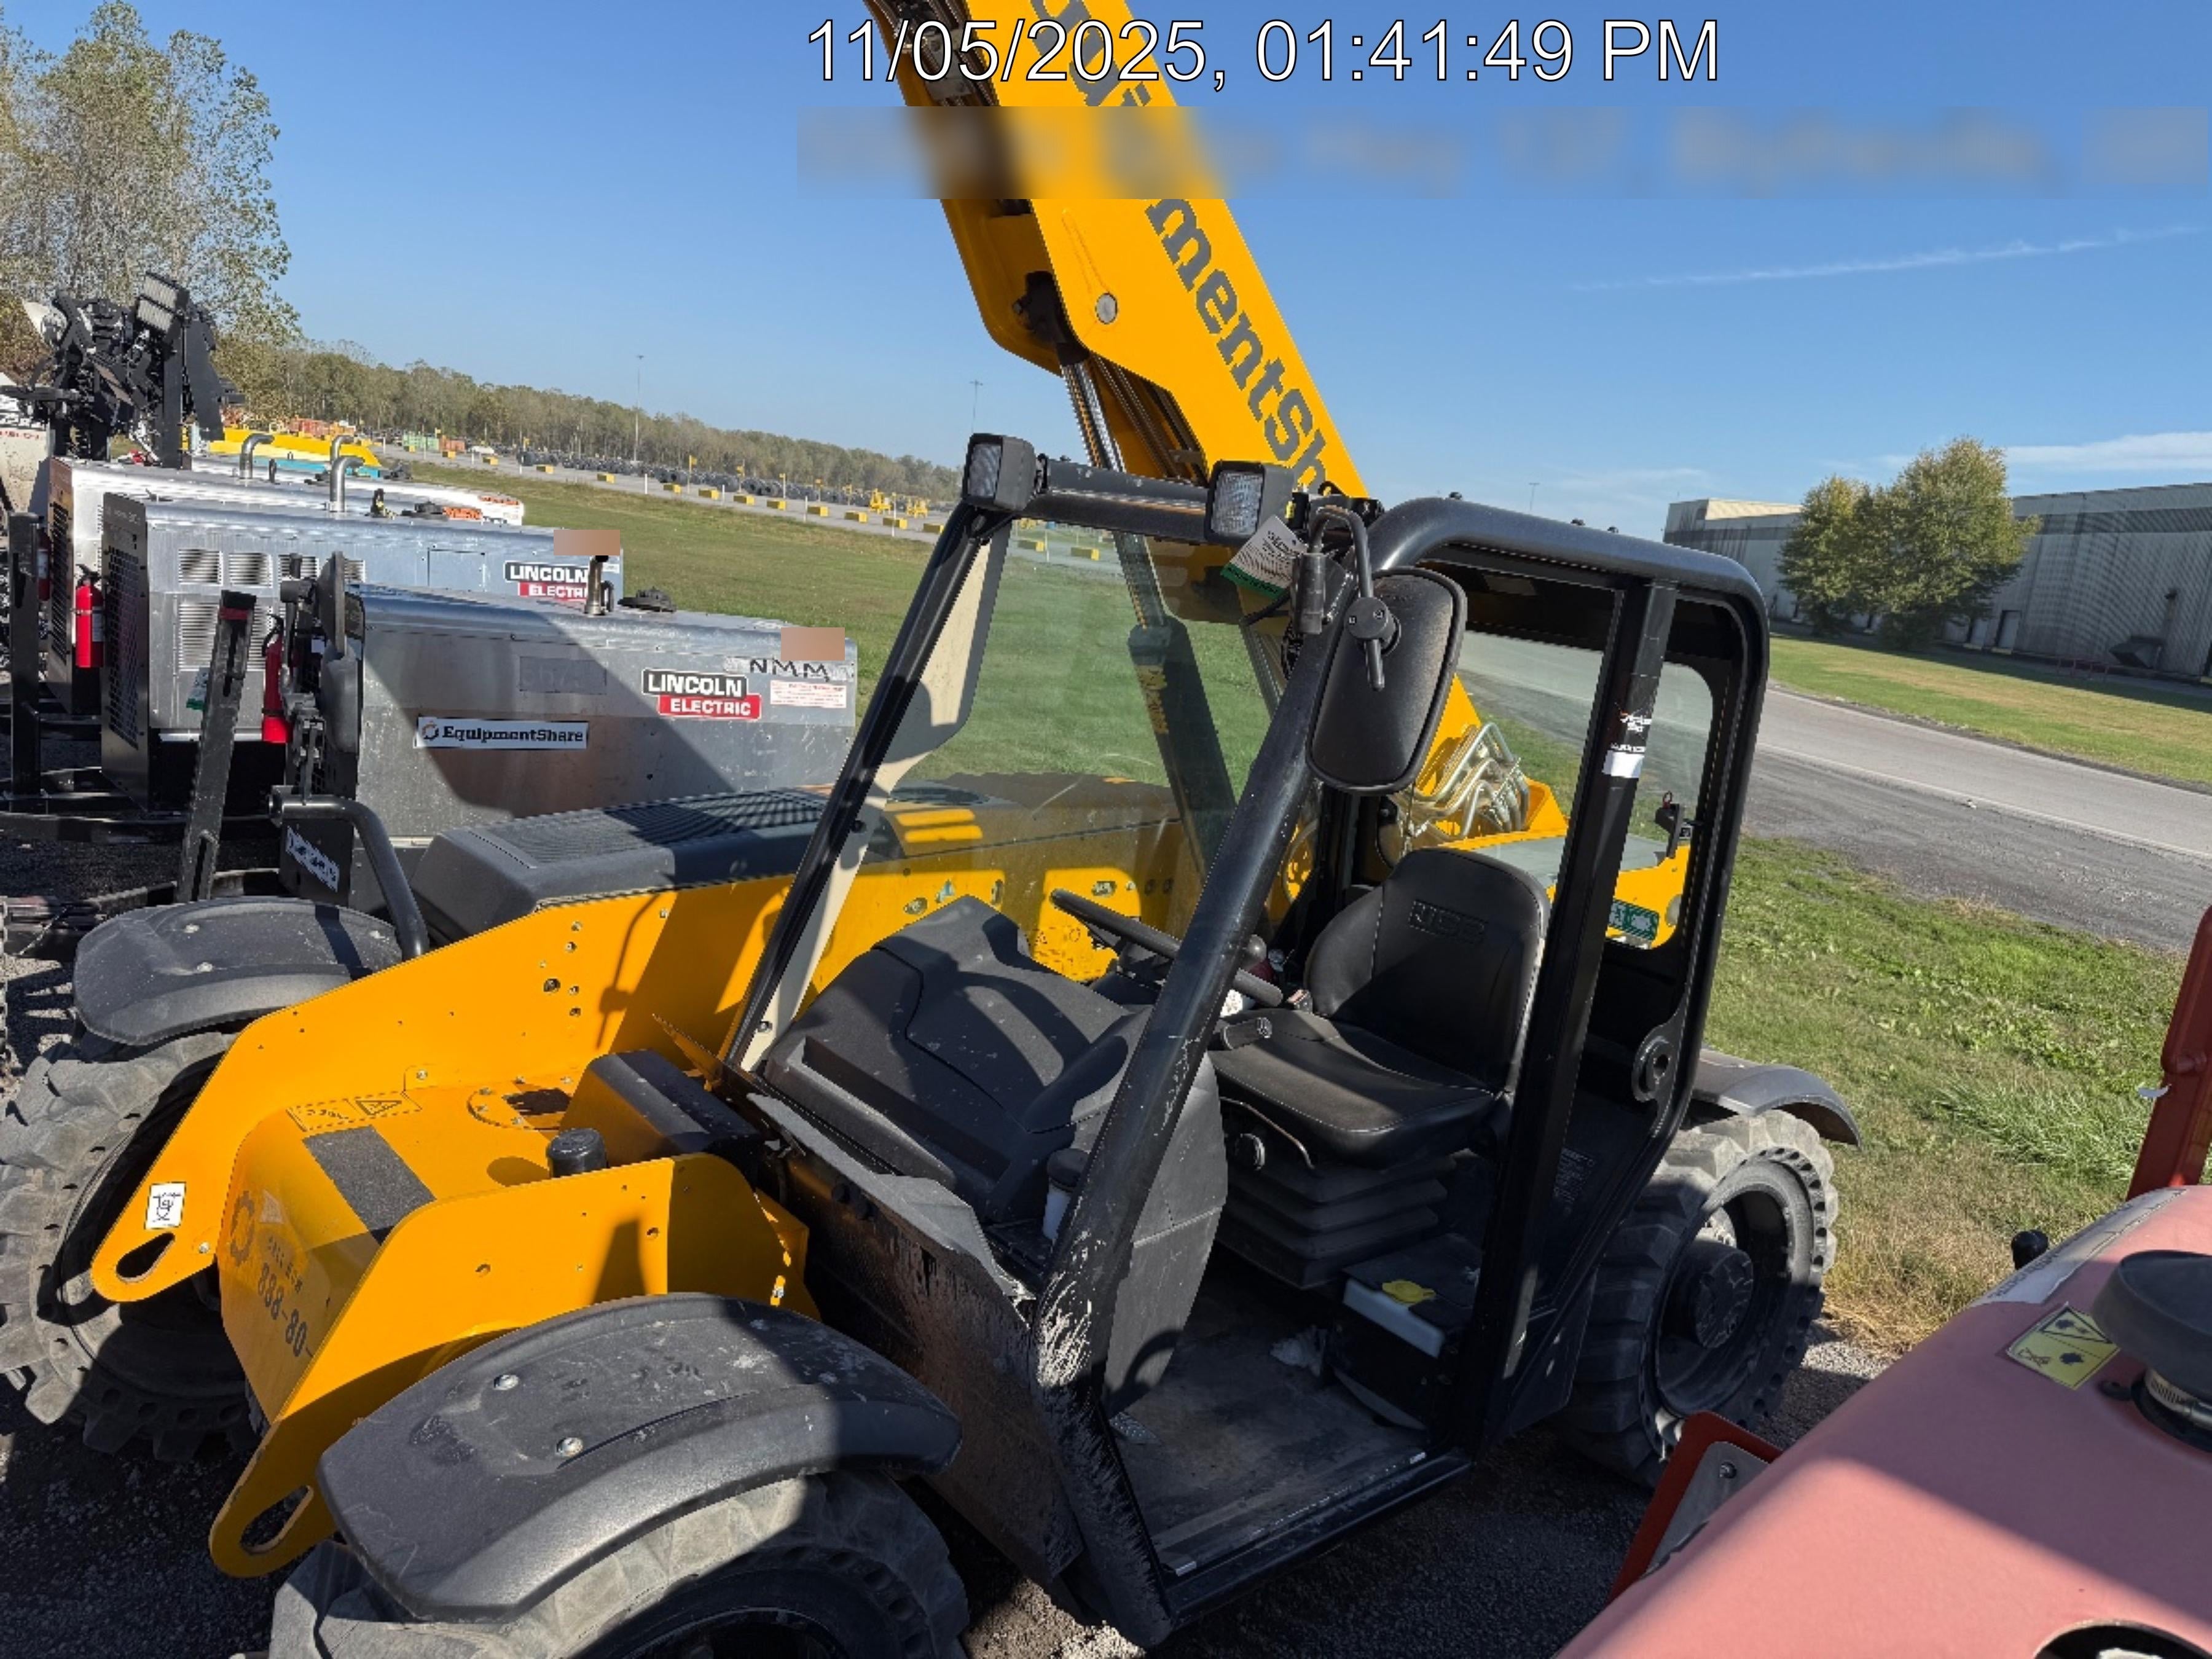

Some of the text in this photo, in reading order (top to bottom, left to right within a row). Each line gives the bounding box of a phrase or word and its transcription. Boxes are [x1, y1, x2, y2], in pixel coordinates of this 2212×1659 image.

[510, 565, 588, 582] LINCOLN
[648, 673, 742, 696] LINCOLN
[670, 699, 751, 715] ELECTRIC
[442, 726, 584, 743] EquipmentShare
